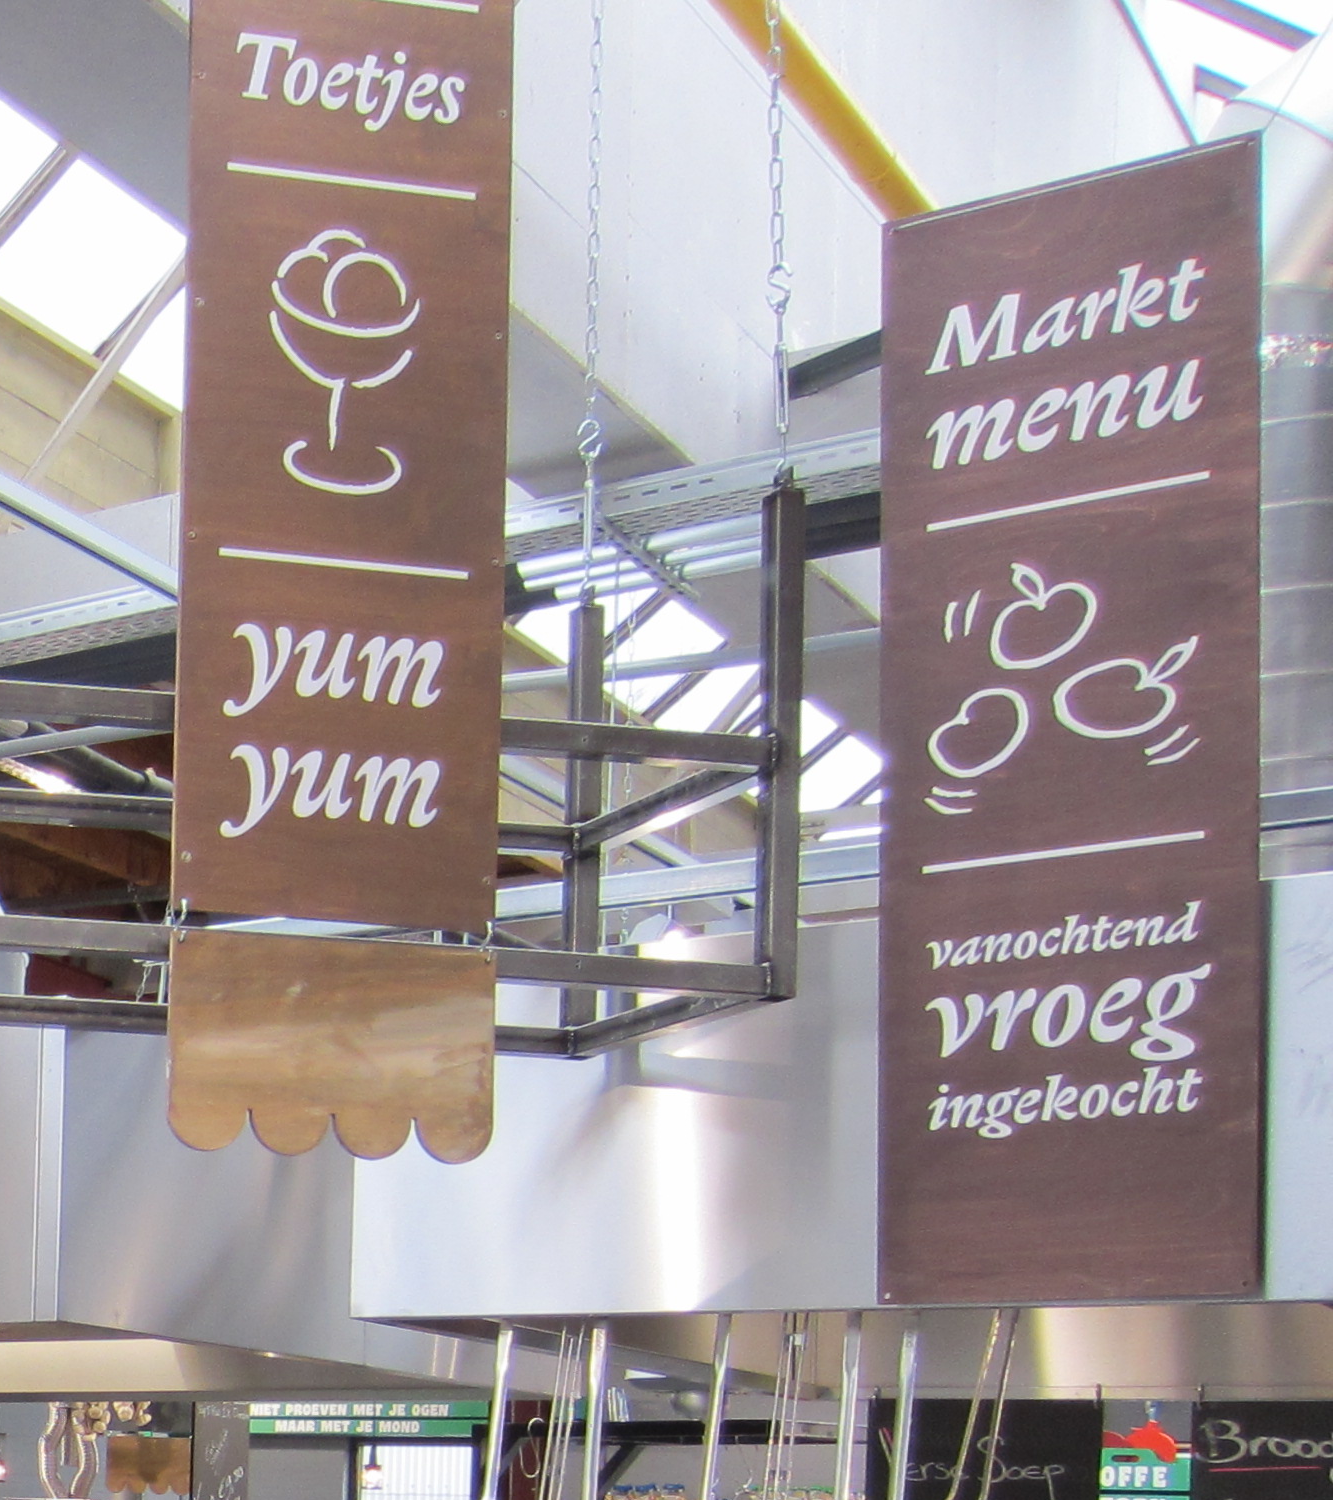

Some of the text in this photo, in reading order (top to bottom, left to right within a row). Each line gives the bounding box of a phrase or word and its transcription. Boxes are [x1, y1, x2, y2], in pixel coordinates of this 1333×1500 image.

[236, 31, 466, 132] Toetjes
[925, 257, 1206, 377] Markt
[925, 357, 1206, 471] menu
[222, 622, 444, 718] yum
[219, 743, 440, 838] yum
[926, 900, 1200, 973] vanochtend
[925, 961, 1213, 1062] vroeg
[928, 1064, 1204, 1140] ingekocht
[250, 1403, 280, 1417] NIET
[285, 1403, 346, 1417] PROEVEN
[353, 1403, 383, 1417] MET
[388, 1403, 406, 1417] JE
[411, 1403, 449, 1418] OGEN
[275, 1419, 421, 1434] MAAR MET JE MOND
